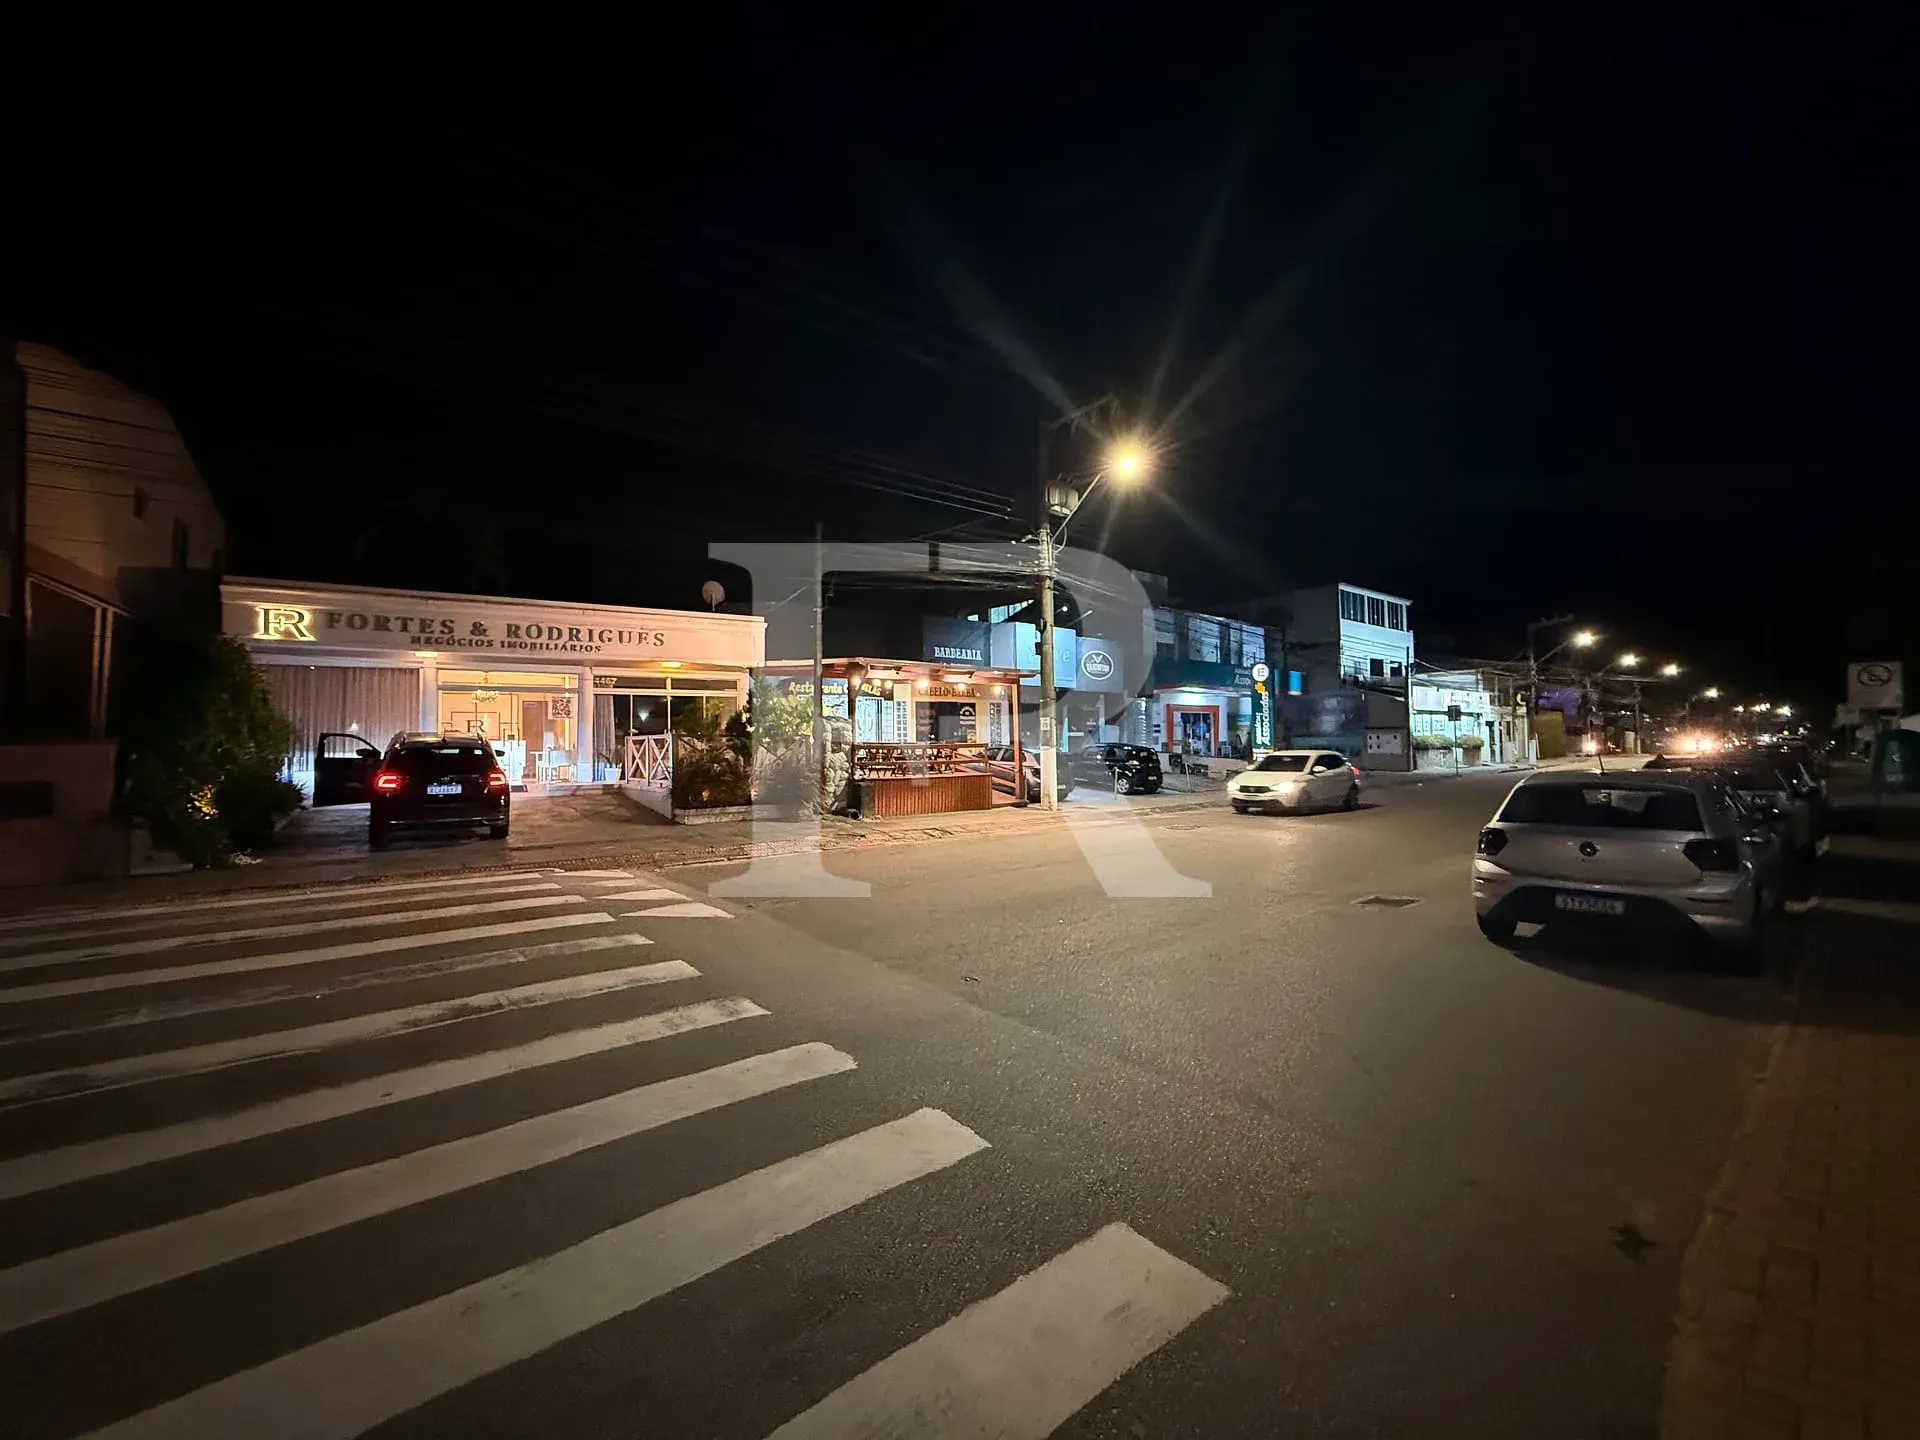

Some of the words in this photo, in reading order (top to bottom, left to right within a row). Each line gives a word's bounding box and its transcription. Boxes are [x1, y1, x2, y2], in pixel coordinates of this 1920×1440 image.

[324, 612, 455, 635] FORTES
[470, 620, 489, 637] &
[506, 623, 666, 647] RODRIGUES
[410, 635, 494, 648] NEGÓCIOS
[500, 639, 601, 653] IMOBILIÁRIOS
[934, 646, 983, 661] BARBEARIA
